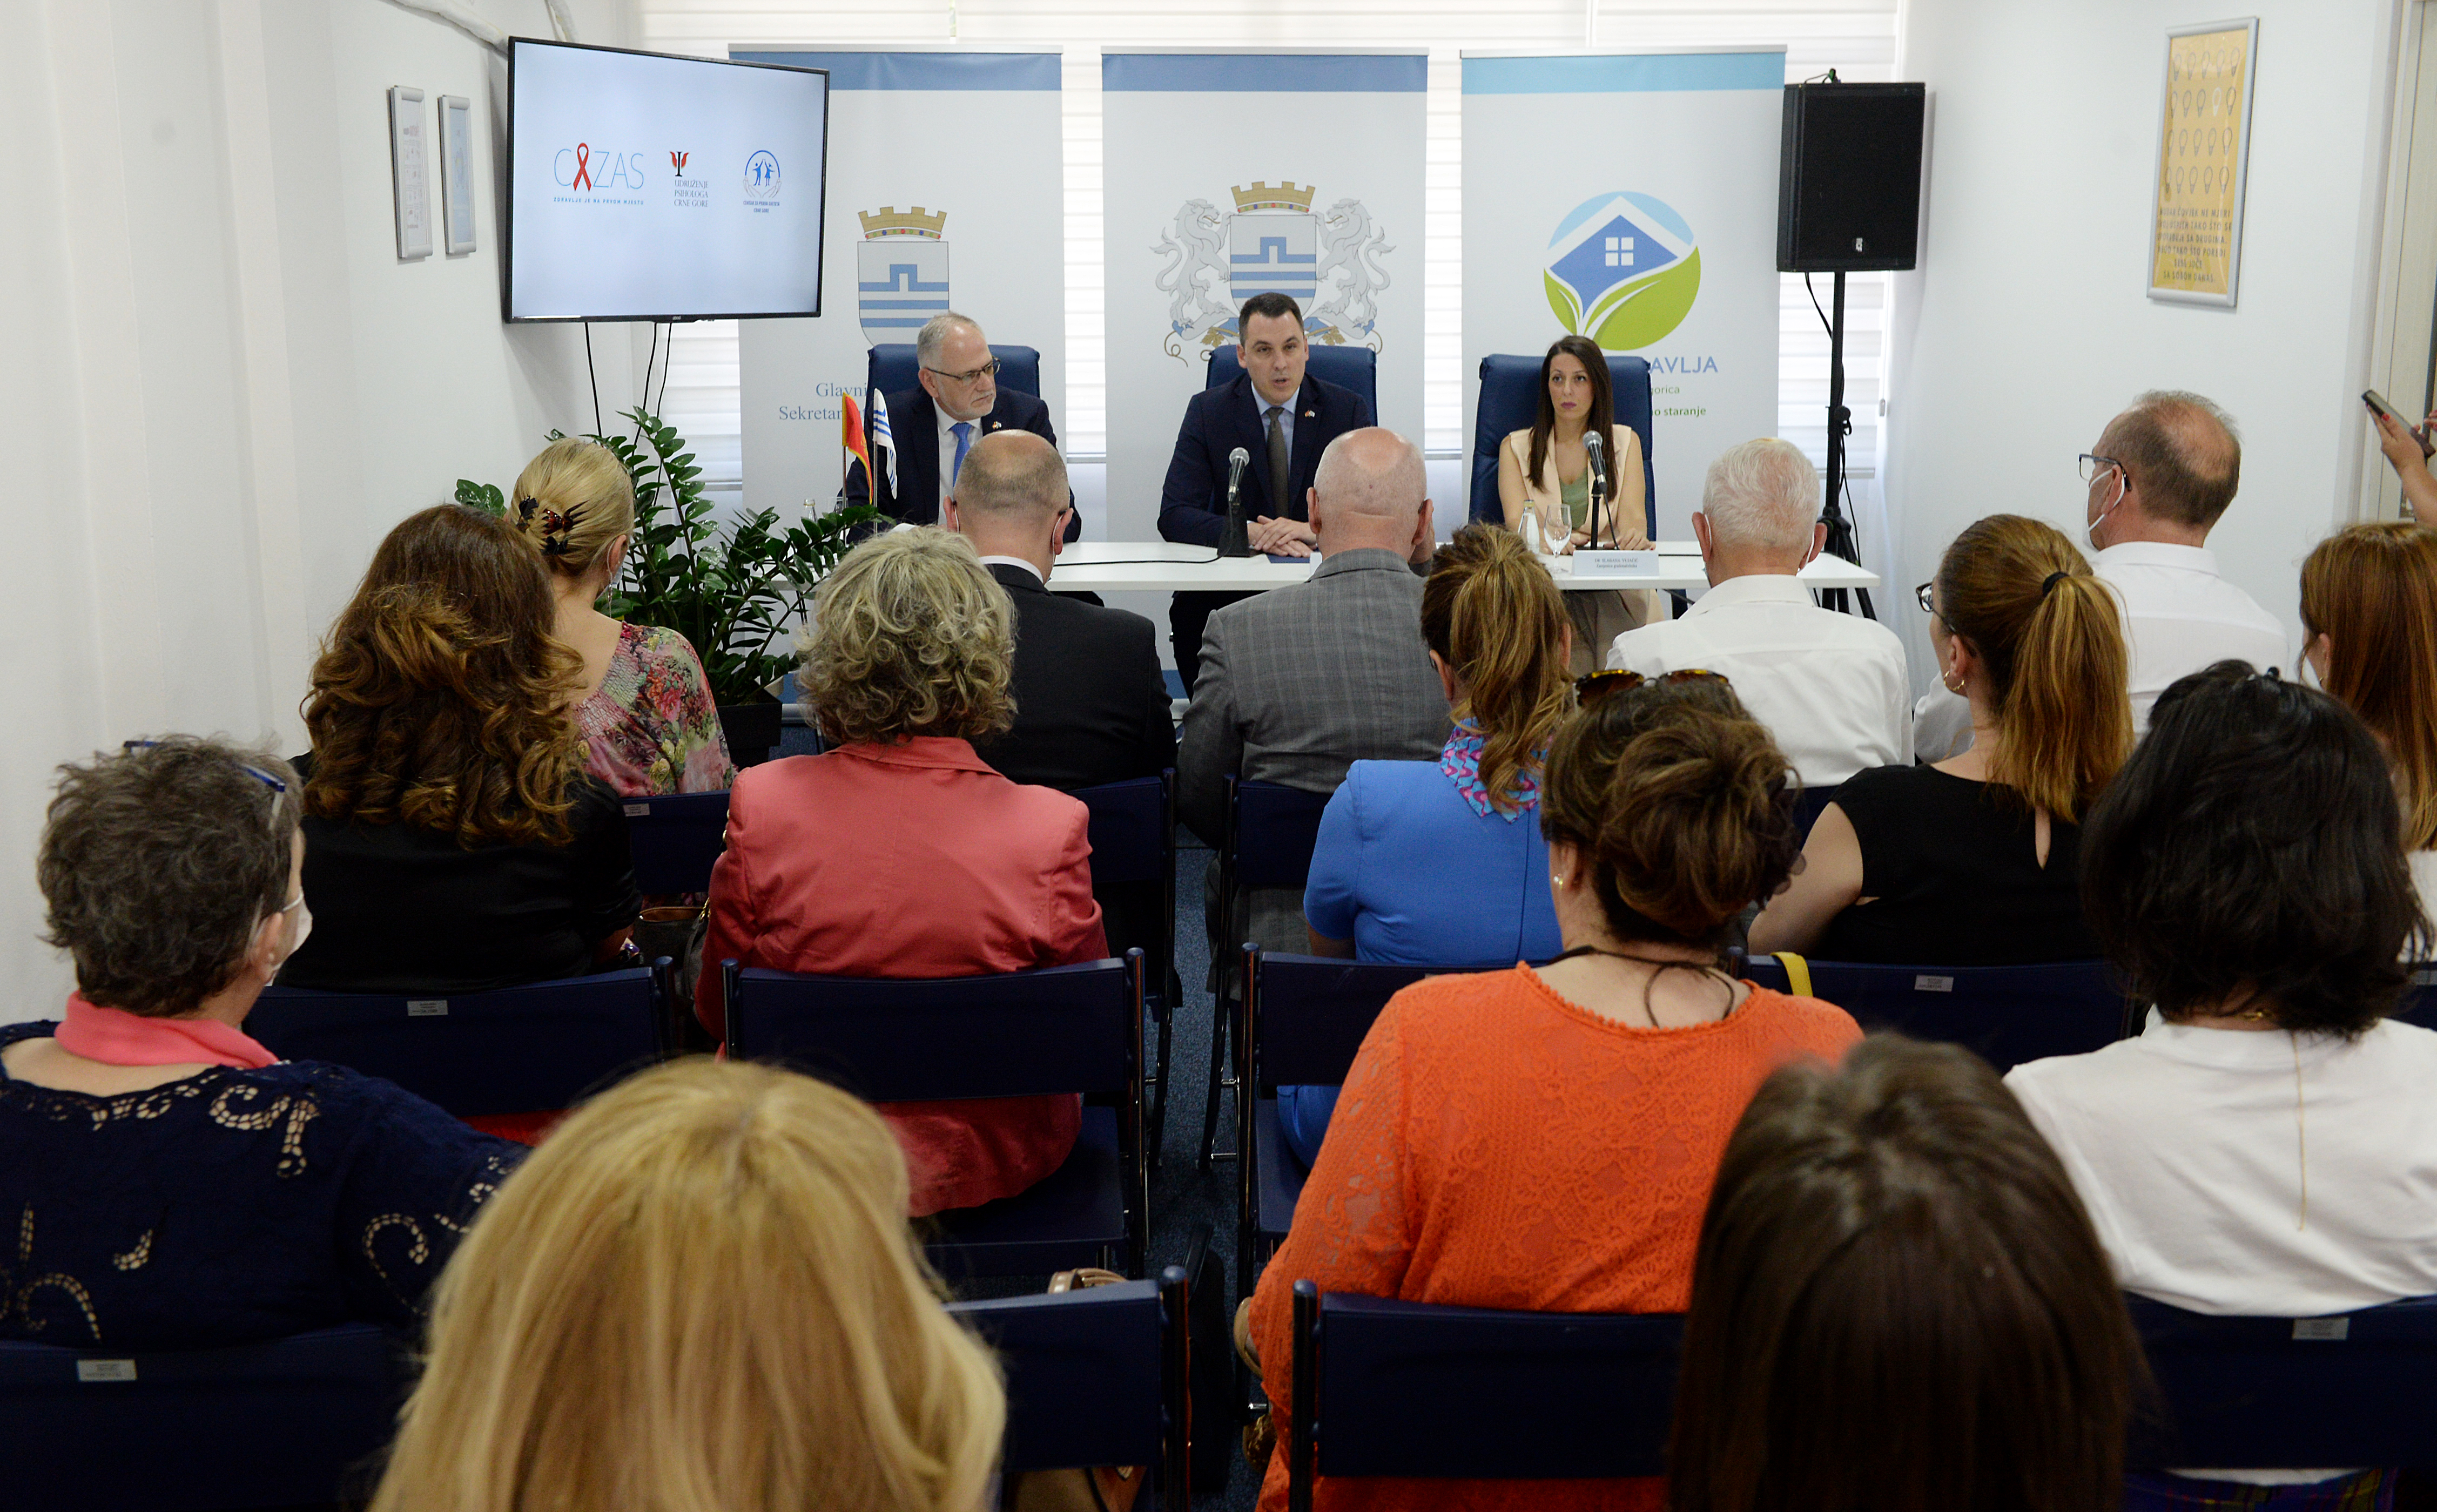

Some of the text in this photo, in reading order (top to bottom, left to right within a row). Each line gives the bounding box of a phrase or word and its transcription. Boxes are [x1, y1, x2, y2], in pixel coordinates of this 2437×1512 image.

[675, 179, 709, 189] UDRUŽENJE
[674, 190, 709, 198] PSIHOLOGA
[691, 199, 709, 207] GORE
[2202, 208, 2209, 217] NE
[2191, 221, 2207, 230] TAKO
[2210, 219, 2222, 231] ŠTO
[2225, 221, 2232, 231] SE
[1650, 356, 1719, 374] AVLJA
[816, 382, 867, 397] Glavni
[1652, 384, 1680, 396] orica
[1664, 406, 1706, 417] staranje
